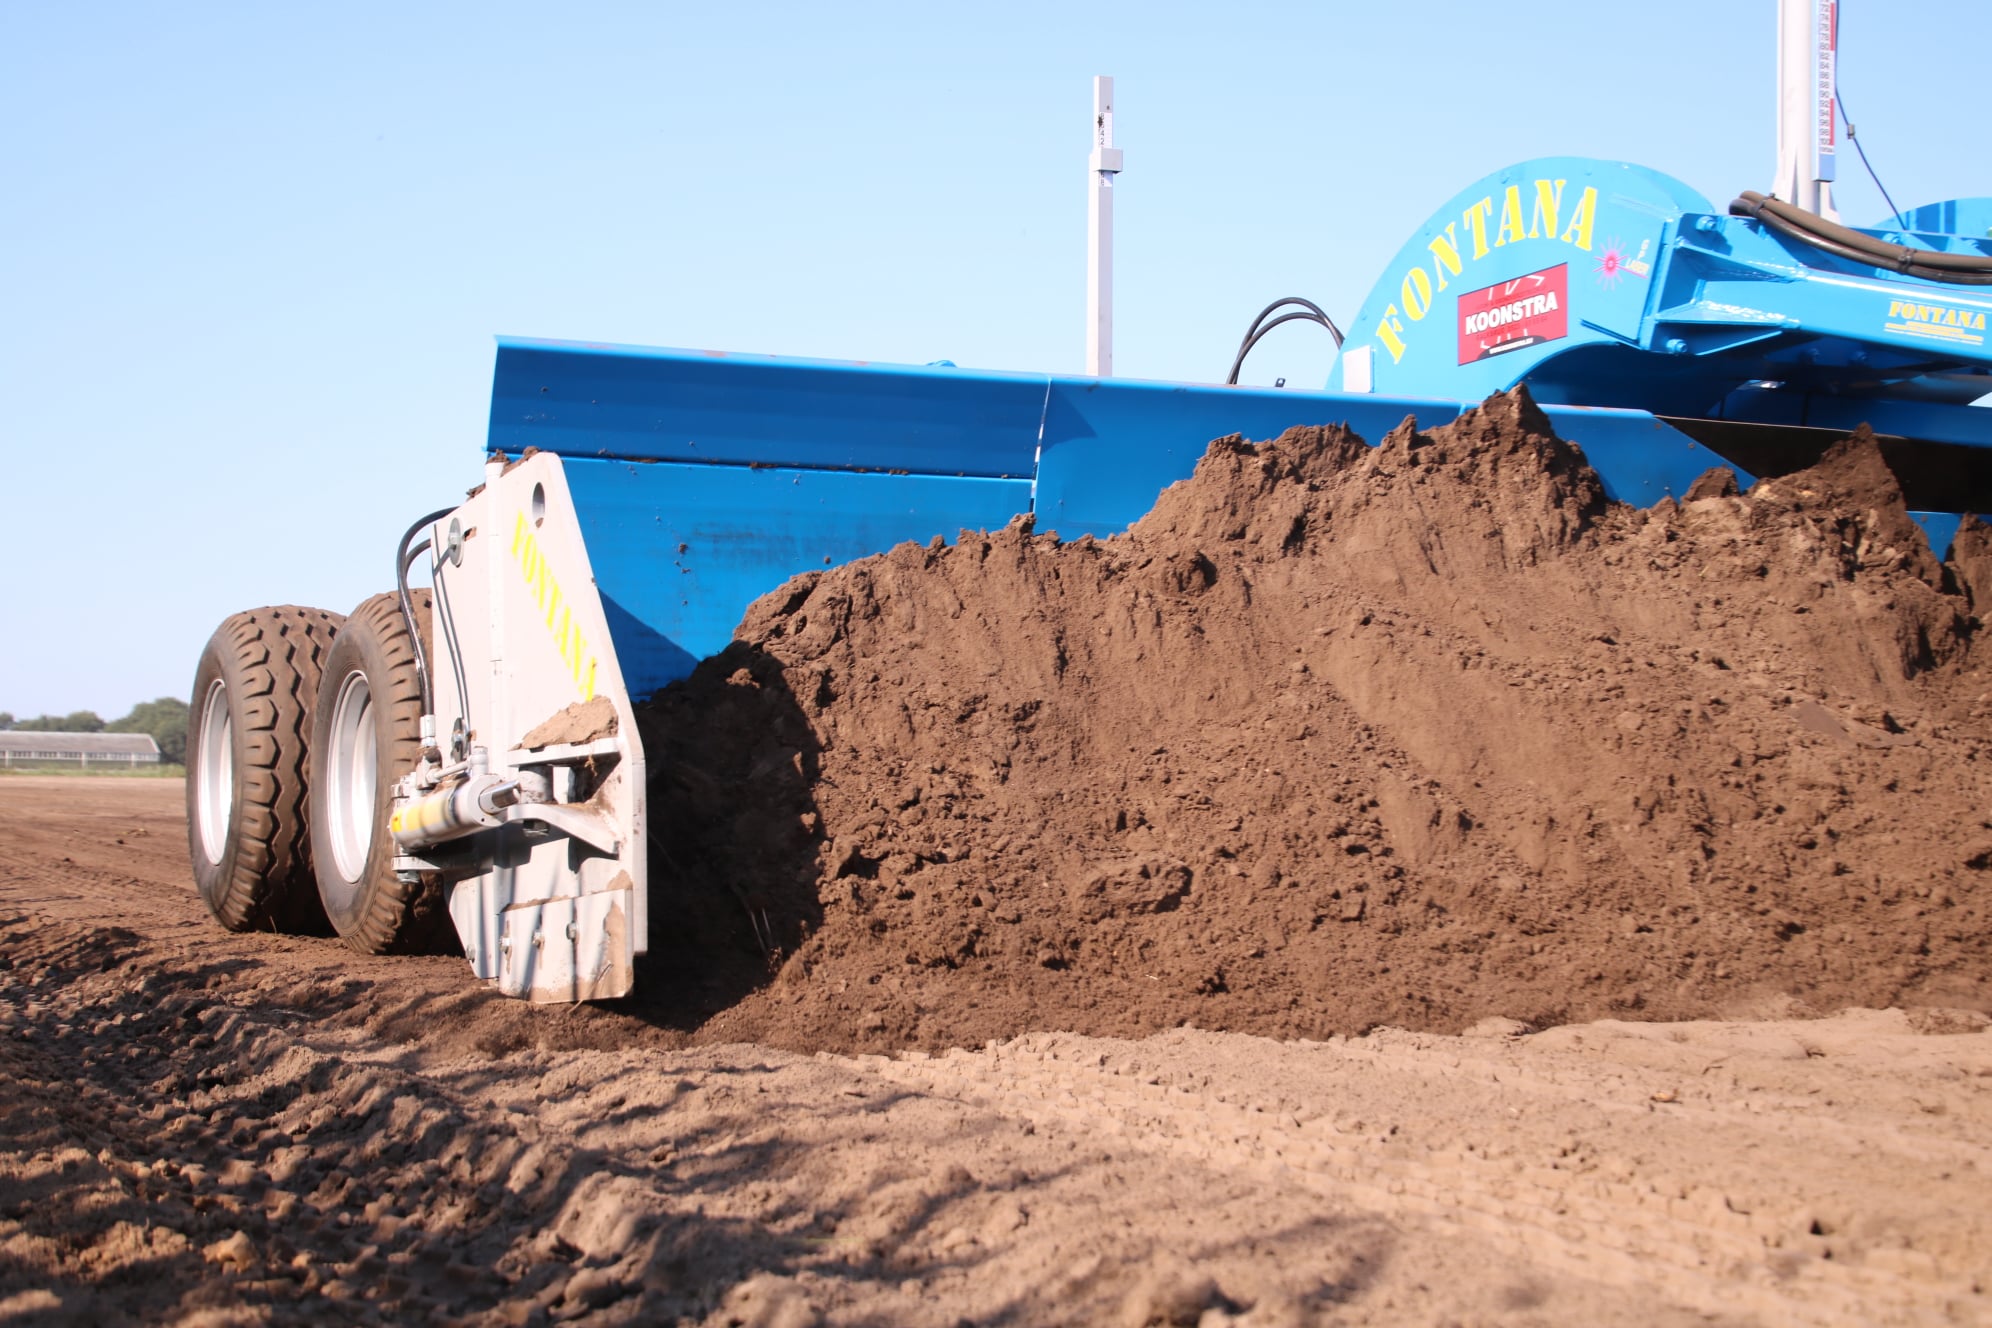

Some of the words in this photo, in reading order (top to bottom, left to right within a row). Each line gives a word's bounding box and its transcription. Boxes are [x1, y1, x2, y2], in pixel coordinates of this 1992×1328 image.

[1375, 179, 1599, 365] FONTANA
[1465, 291, 1559, 335] KOONSTRA
[1887, 301, 1986, 331] FONTANA
[511, 510, 598, 702] FONTANA
